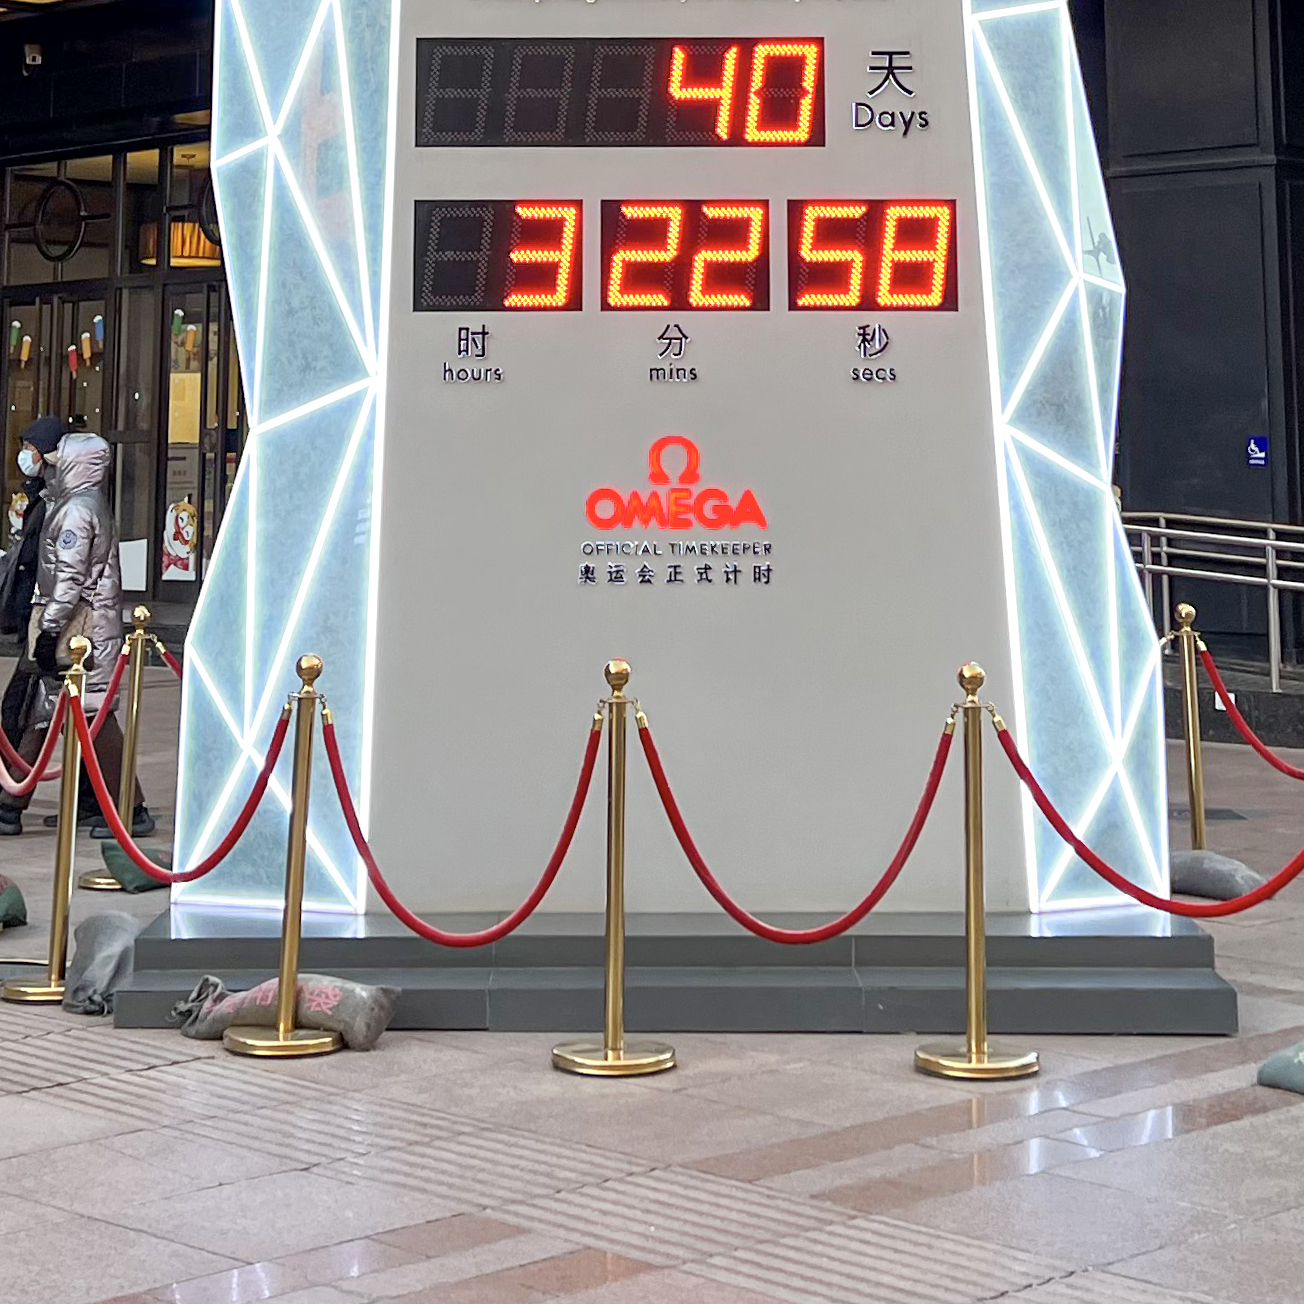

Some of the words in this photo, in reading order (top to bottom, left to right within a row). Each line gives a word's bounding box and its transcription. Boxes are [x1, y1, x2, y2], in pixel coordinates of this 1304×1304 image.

[866, 49, 916, 99] 天
[667, 41, 821, 144] 40
[851, 101, 930, 138] Days
[502, 203, 579, 309] 3
[605, 203, 765, 309] 22
[794, 203, 953, 309] 58
[456, 324, 491, 359] 时
[656, 323, 690, 359] 分
[856, 323, 890, 360] 秒
[442, 361, 503, 383] hours
[648, 363, 698, 383] mins
[850, 365, 898, 383] secs
[584, 487, 769, 531] OMEGA
[580, 540, 663, 557] OFFICIAL
[668, 540, 773, 556] TIMEKEEPER
[578, 563, 774, 586] 奥运会正式计时
